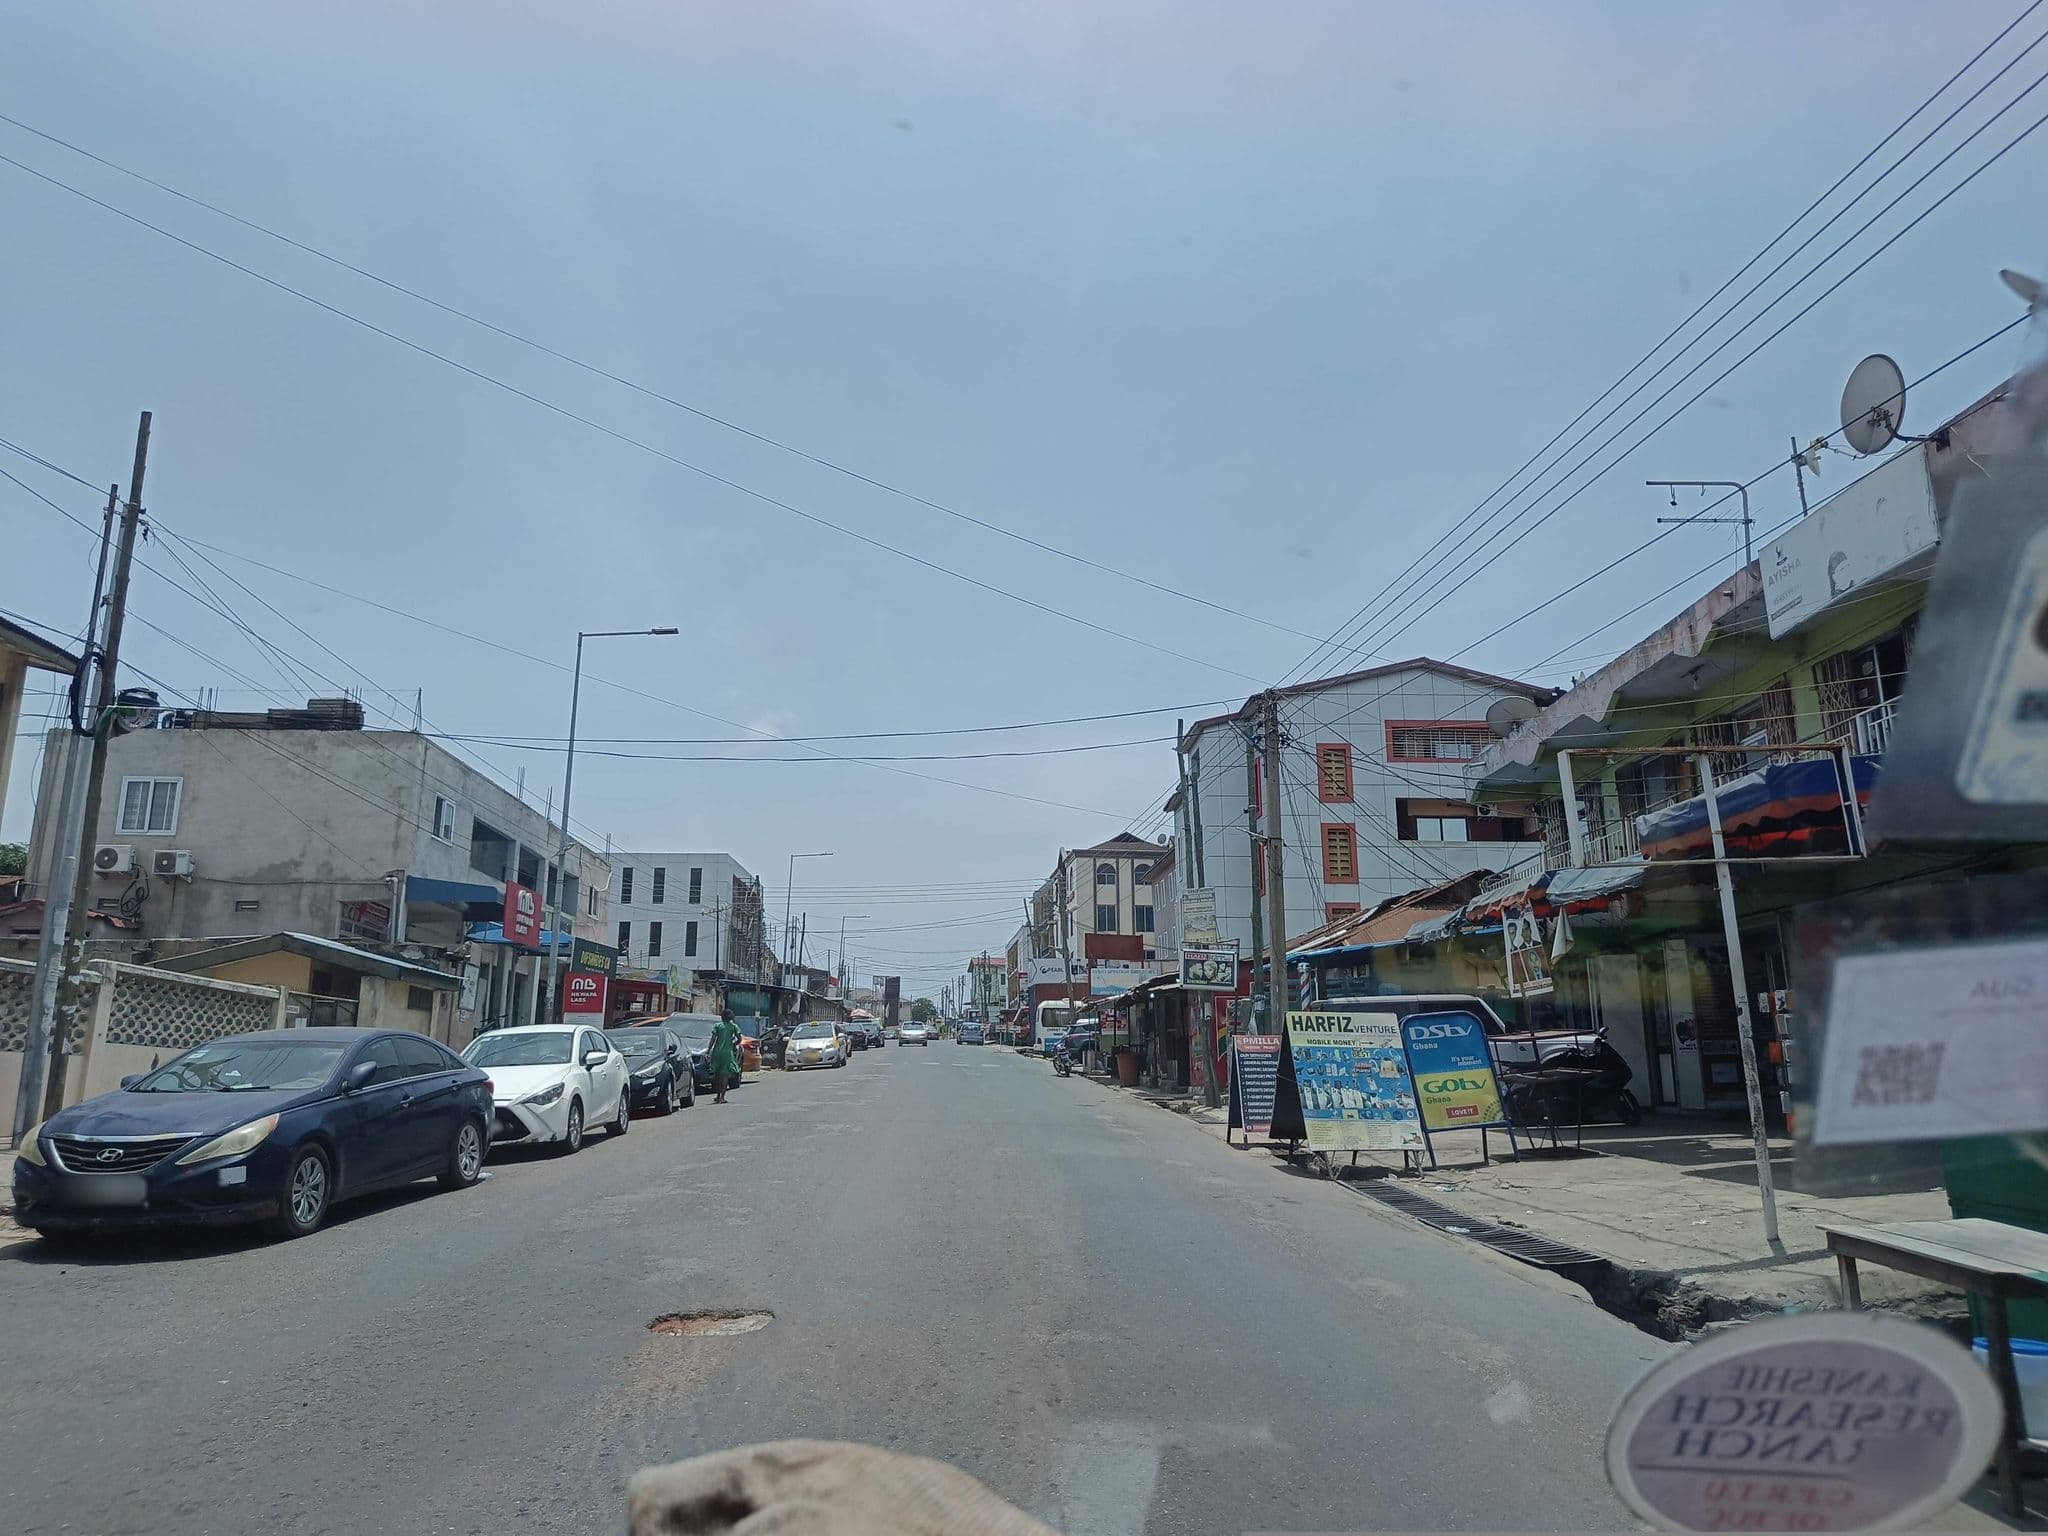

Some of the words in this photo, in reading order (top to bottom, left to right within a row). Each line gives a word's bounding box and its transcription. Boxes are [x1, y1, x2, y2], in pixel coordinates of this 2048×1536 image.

[1767, 557, 1801, 587] AYISHA
[1291, 1015, 1354, 1033] HARFIZ
[1354, 1025, 1397, 1034] VENTURE
[1412, 1042, 1439, 1050] Ghana
[1426, 1096, 1452, 1105] Ghana
